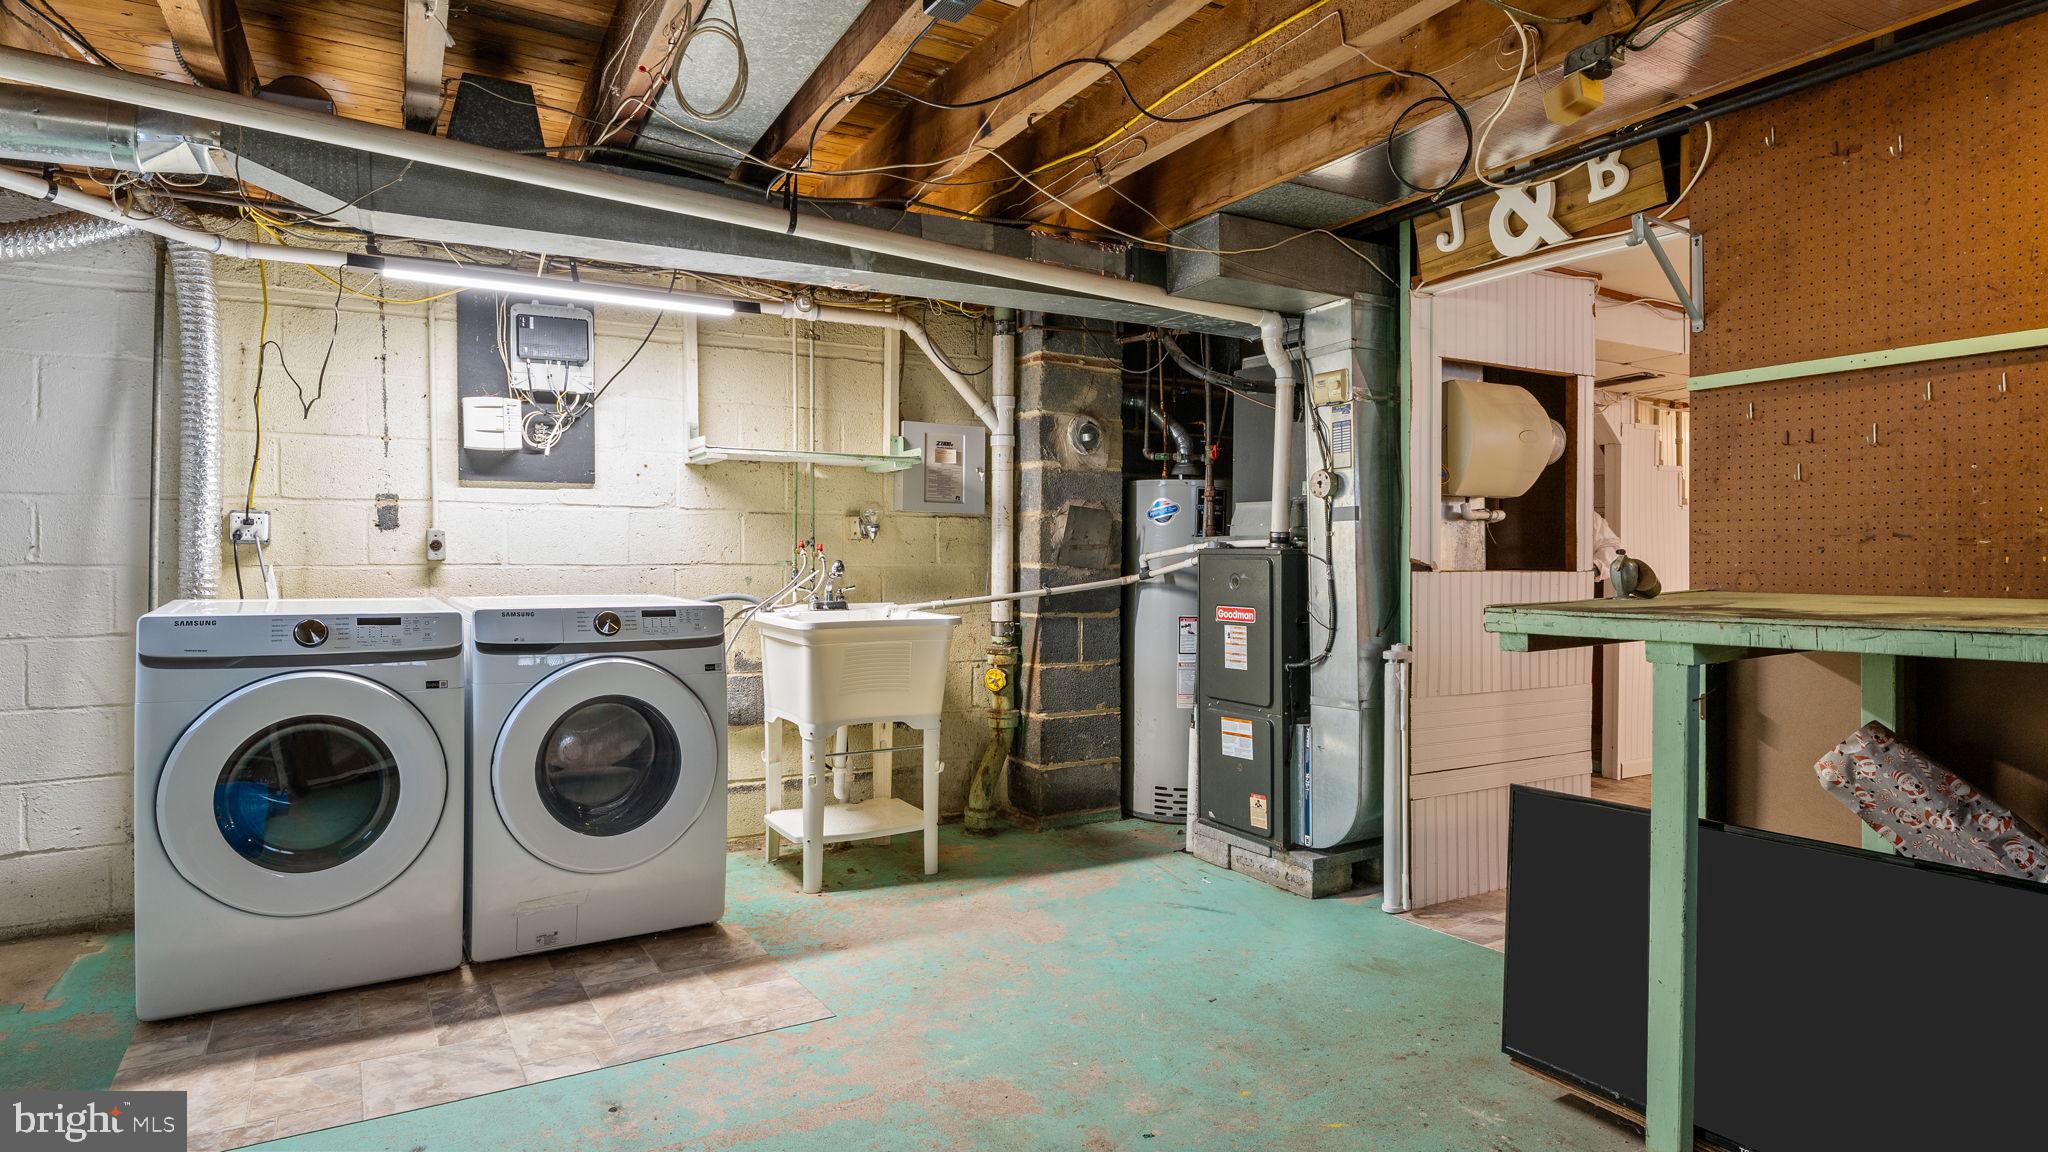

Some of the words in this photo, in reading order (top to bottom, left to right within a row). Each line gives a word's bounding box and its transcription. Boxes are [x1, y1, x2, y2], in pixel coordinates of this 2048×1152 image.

[1436, 202, 1465, 253] J
[1488, 180, 1573, 257] &
[1587, 150, 1630, 204] B
[1217, 608, 1254, 621] Goodman
[174, 619, 217, 627] SAMSUNG
